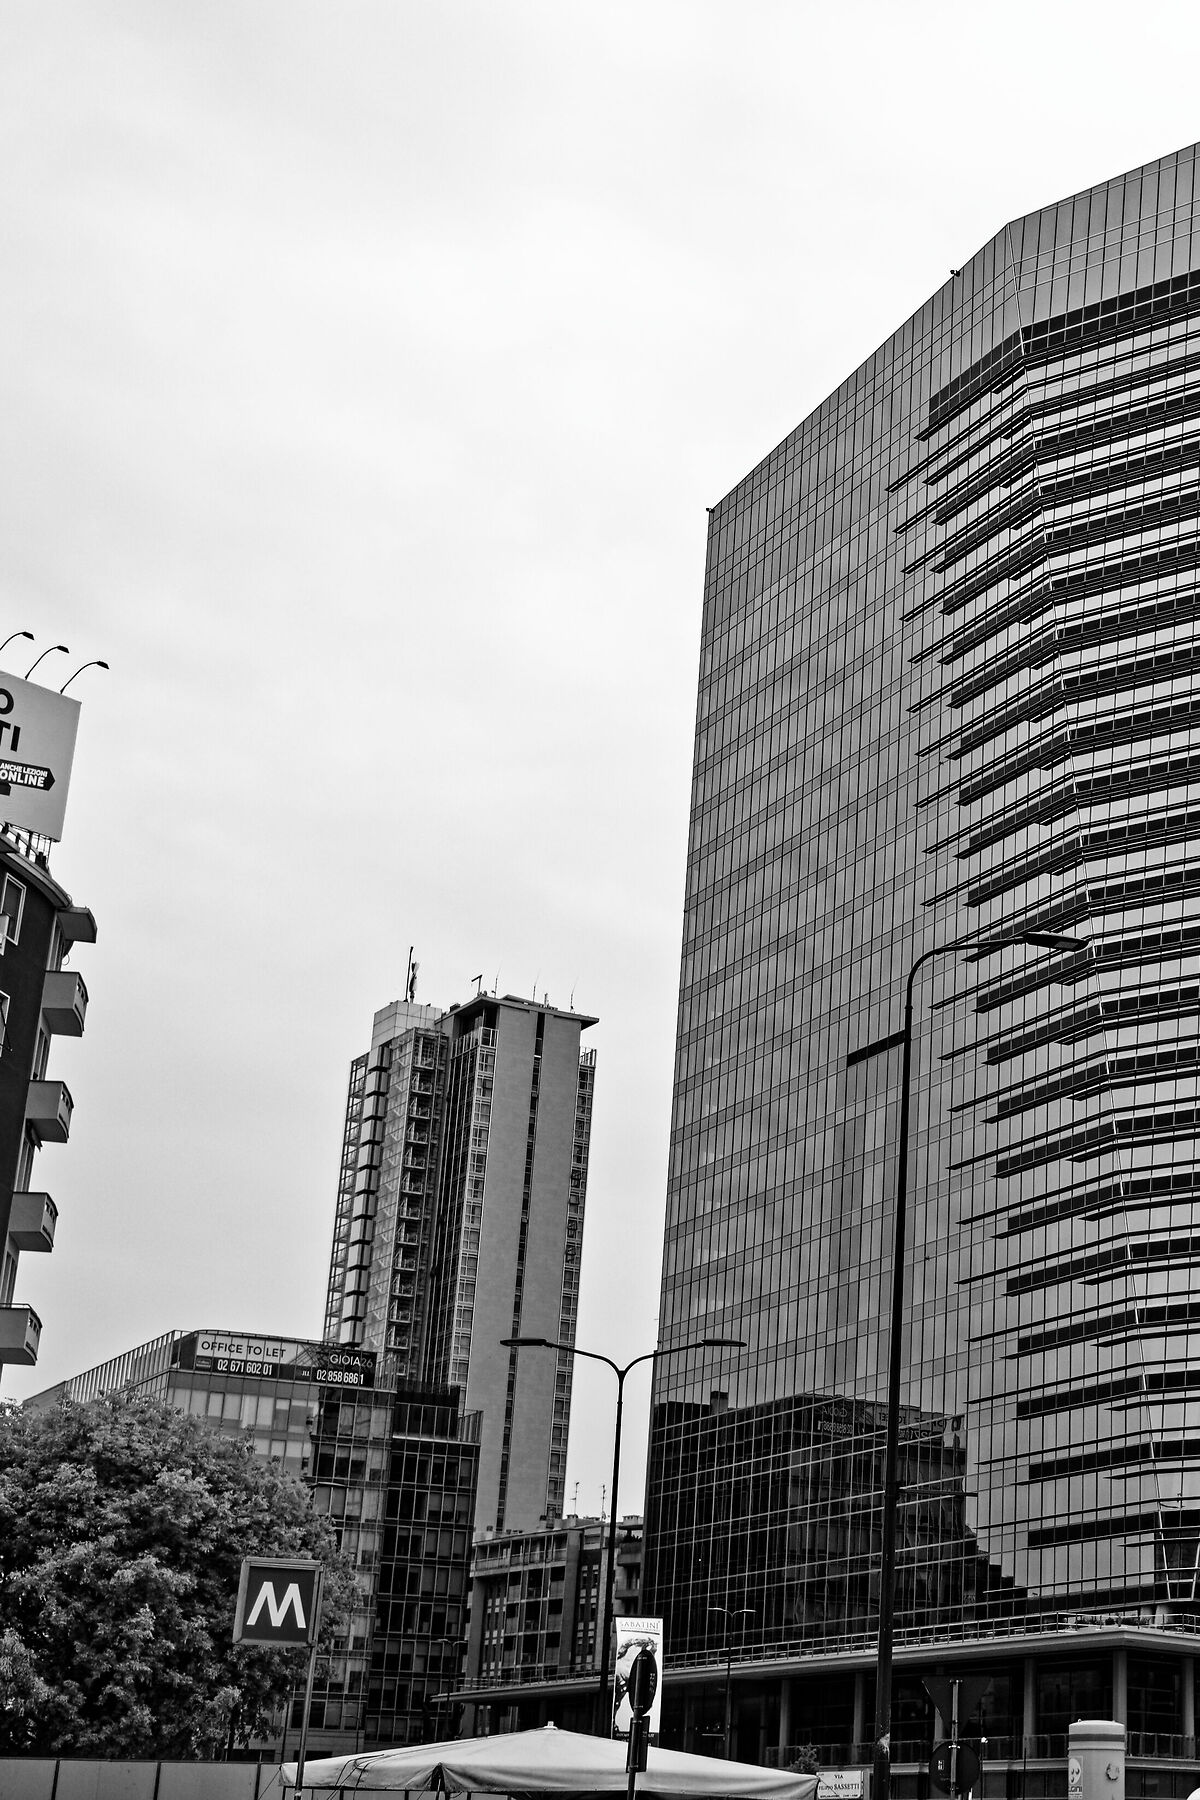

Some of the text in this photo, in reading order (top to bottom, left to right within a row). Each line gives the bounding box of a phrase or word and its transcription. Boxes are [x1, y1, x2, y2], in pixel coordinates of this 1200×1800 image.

[0, 762, 48, 778] ANCHE LEZIONI
[0, 770, 45, 787] ONLINE
[201, 1340, 286, 1358] OFFICE TO LET
[217, 1359, 228, 1371] 02
[230, 1360, 245, 1373] 671
[246, 1361, 261, 1375] 602
[262, 1363, 273, 1376] 01
[316, 1369, 327, 1381] 02
[246, 1581, 306, 1629] M
